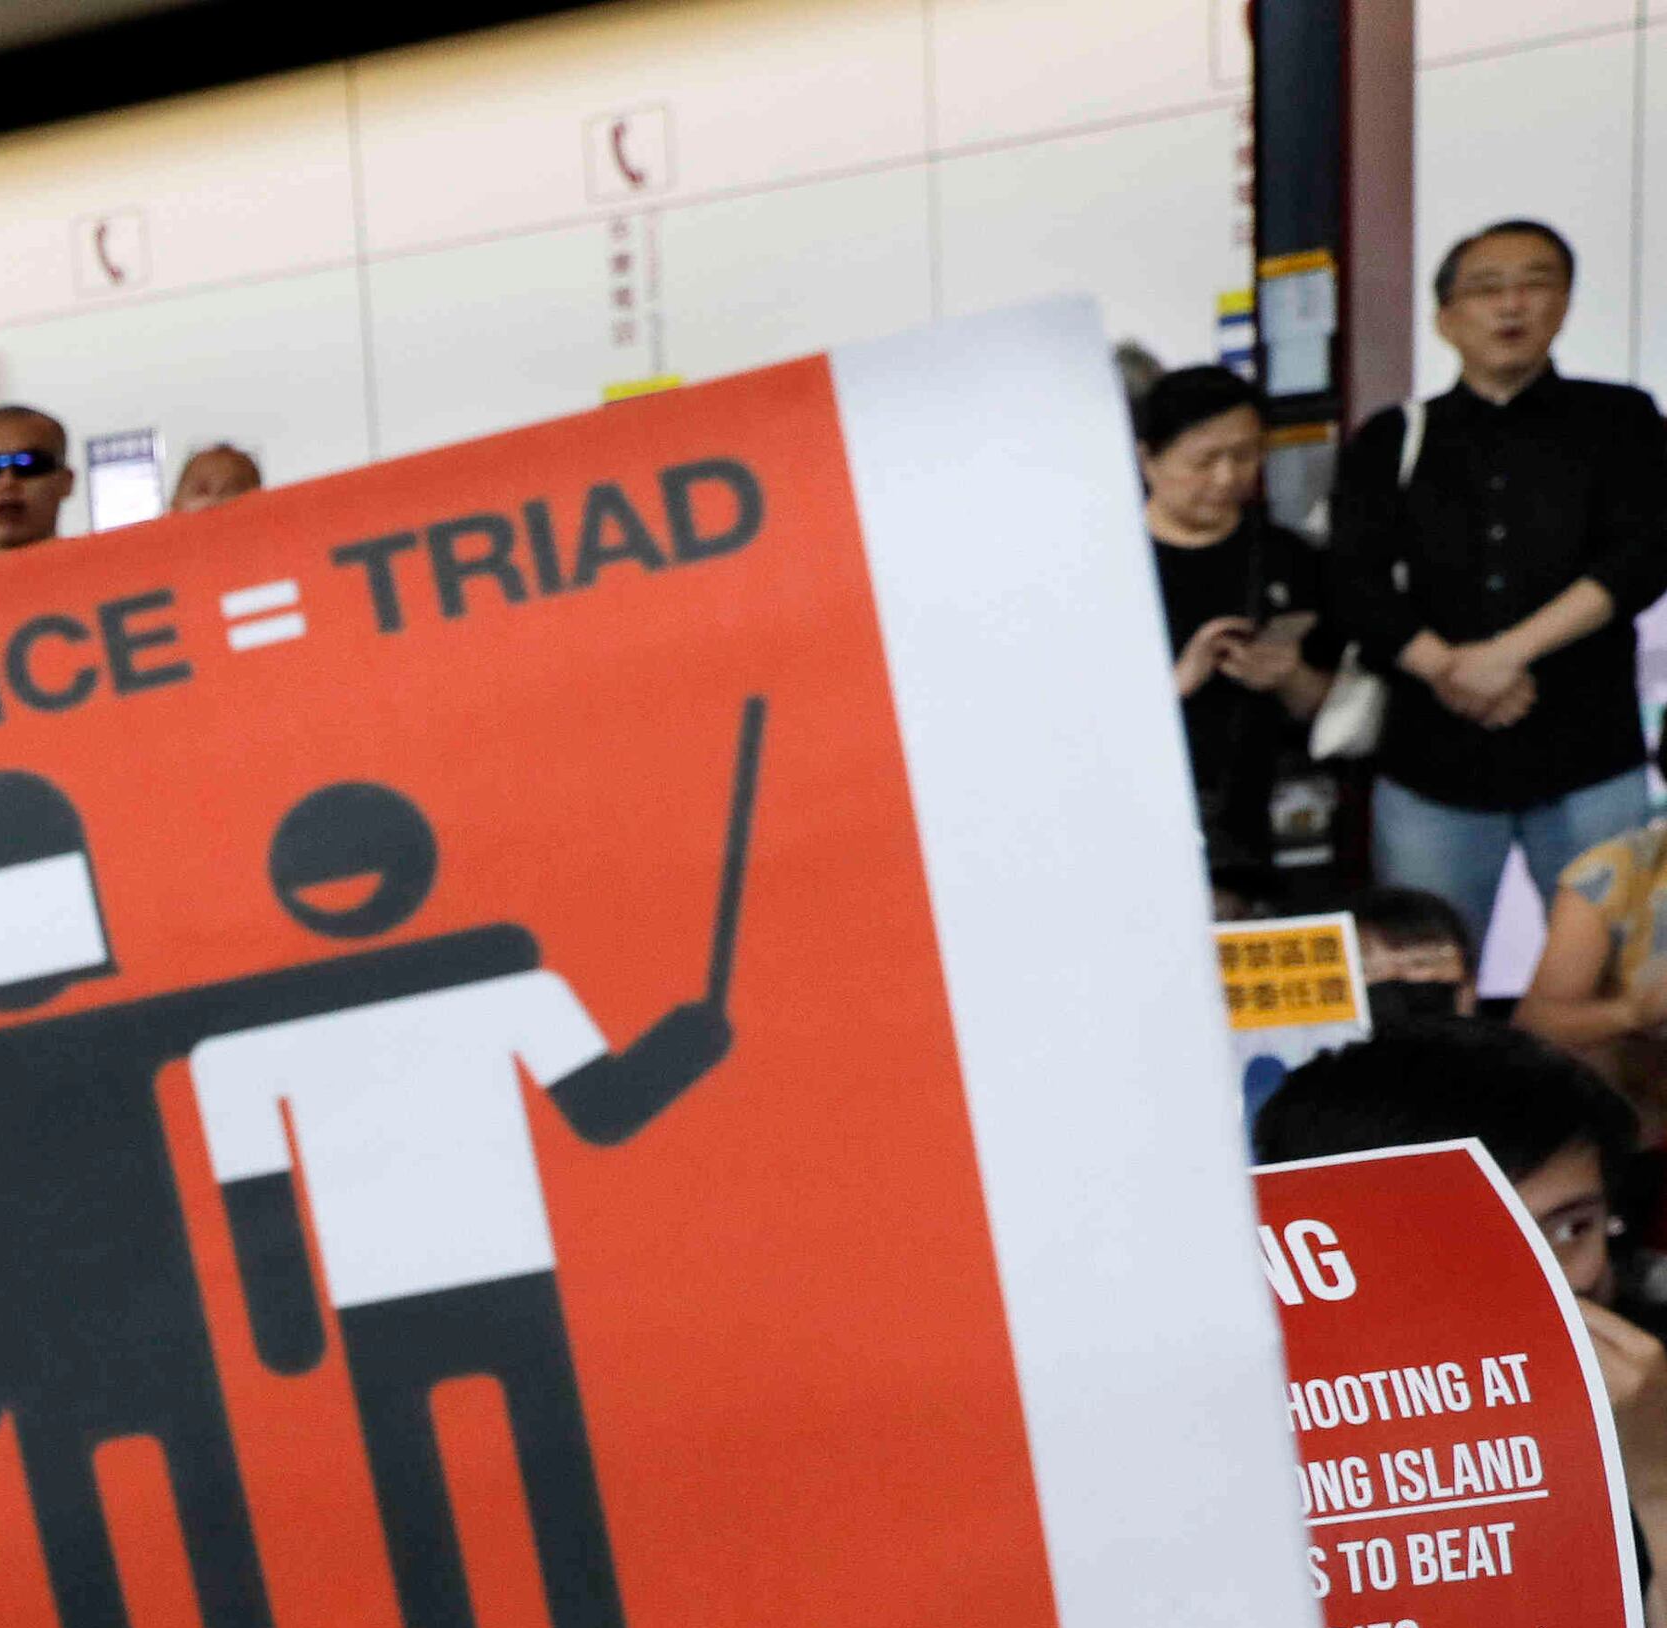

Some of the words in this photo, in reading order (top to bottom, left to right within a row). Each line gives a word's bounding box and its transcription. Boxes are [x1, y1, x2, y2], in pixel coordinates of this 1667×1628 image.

[330, 456, 765, 634] TRIAD
[1257, 1219, 1357, 1306] NG
[1286, 1362, 1472, 1432] HOOTING
[1480, 1353, 1532, 1408] AT
[1379, 1435, 1544, 1505] ISLAND
[1337, 1537, 1398, 1595] TO
[1406, 1522, 1516, 1586] BEAT
